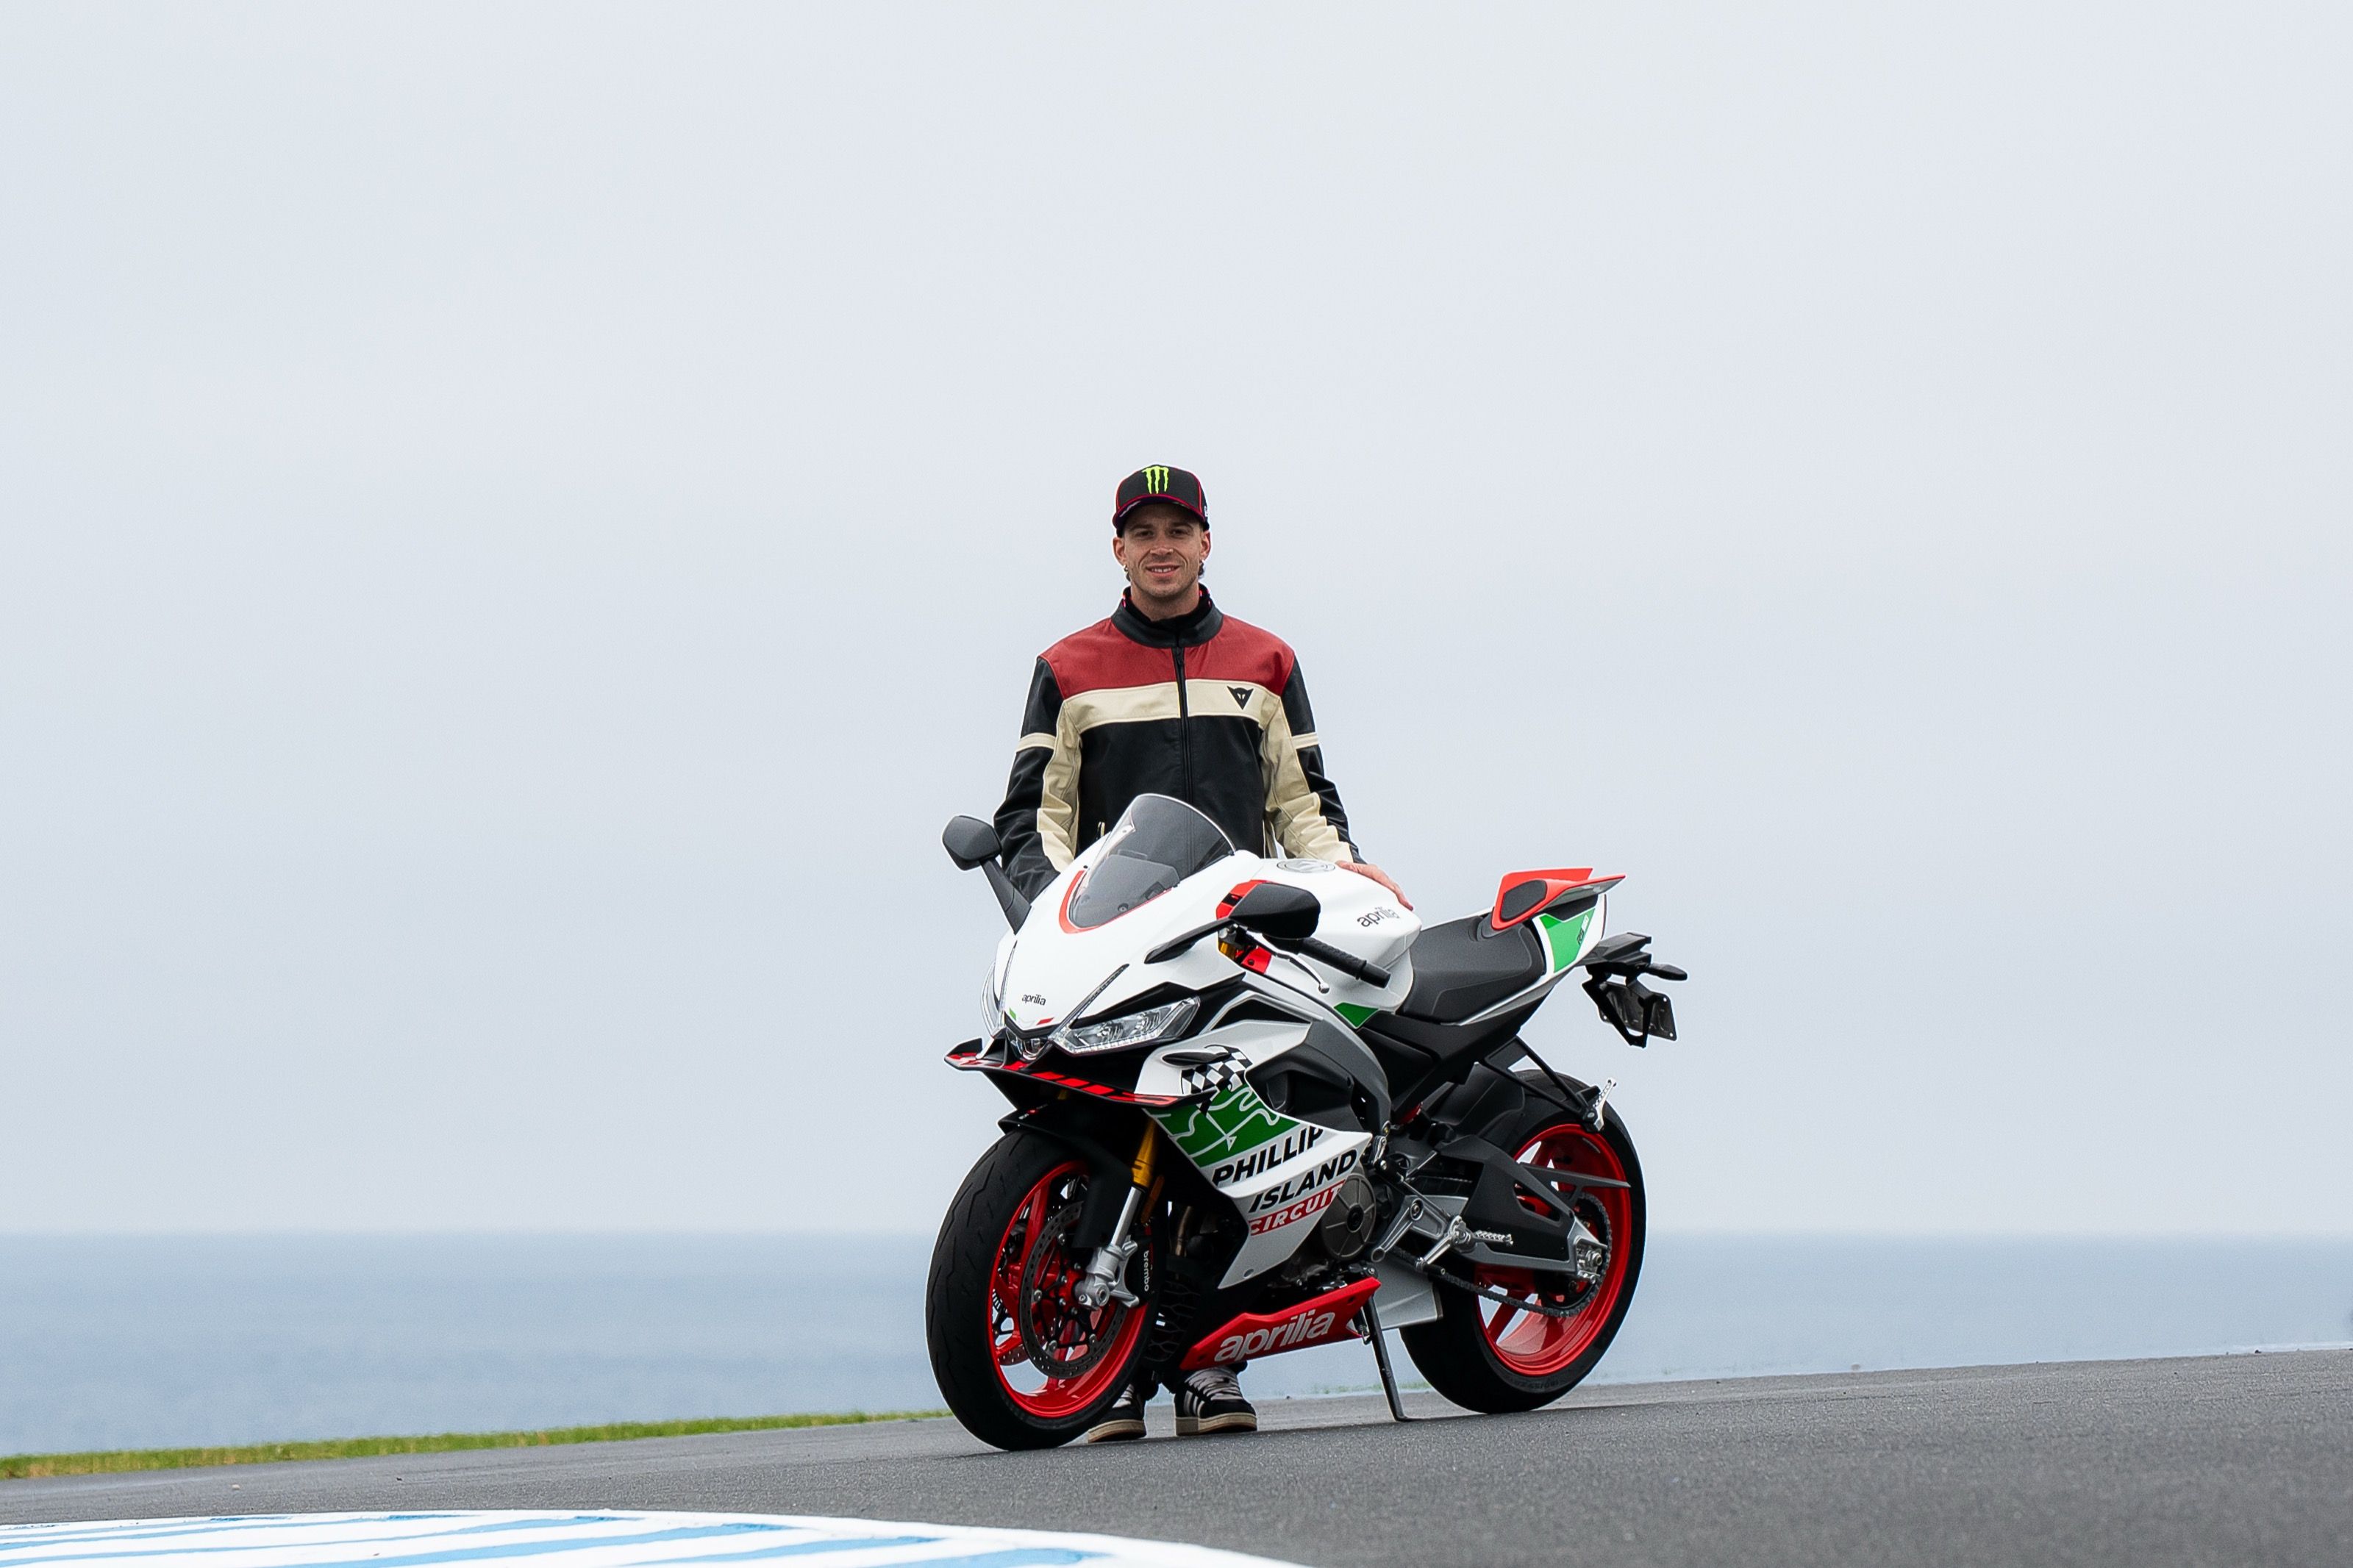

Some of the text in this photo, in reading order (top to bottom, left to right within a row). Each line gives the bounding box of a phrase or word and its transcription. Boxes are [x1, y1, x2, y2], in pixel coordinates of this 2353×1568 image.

[1357, 906, 1401, 928] aprilia
[1021, 994, 1046, 1006] aprilia
[1212, 1125, 1324, 1187] PHILLIP
[1248, 1149, 1357, 1213] ISLAND
[1250, 1183, 1343, 1234] CIRCUIT
[1214, 1309, 1336, 1362] aprilia
